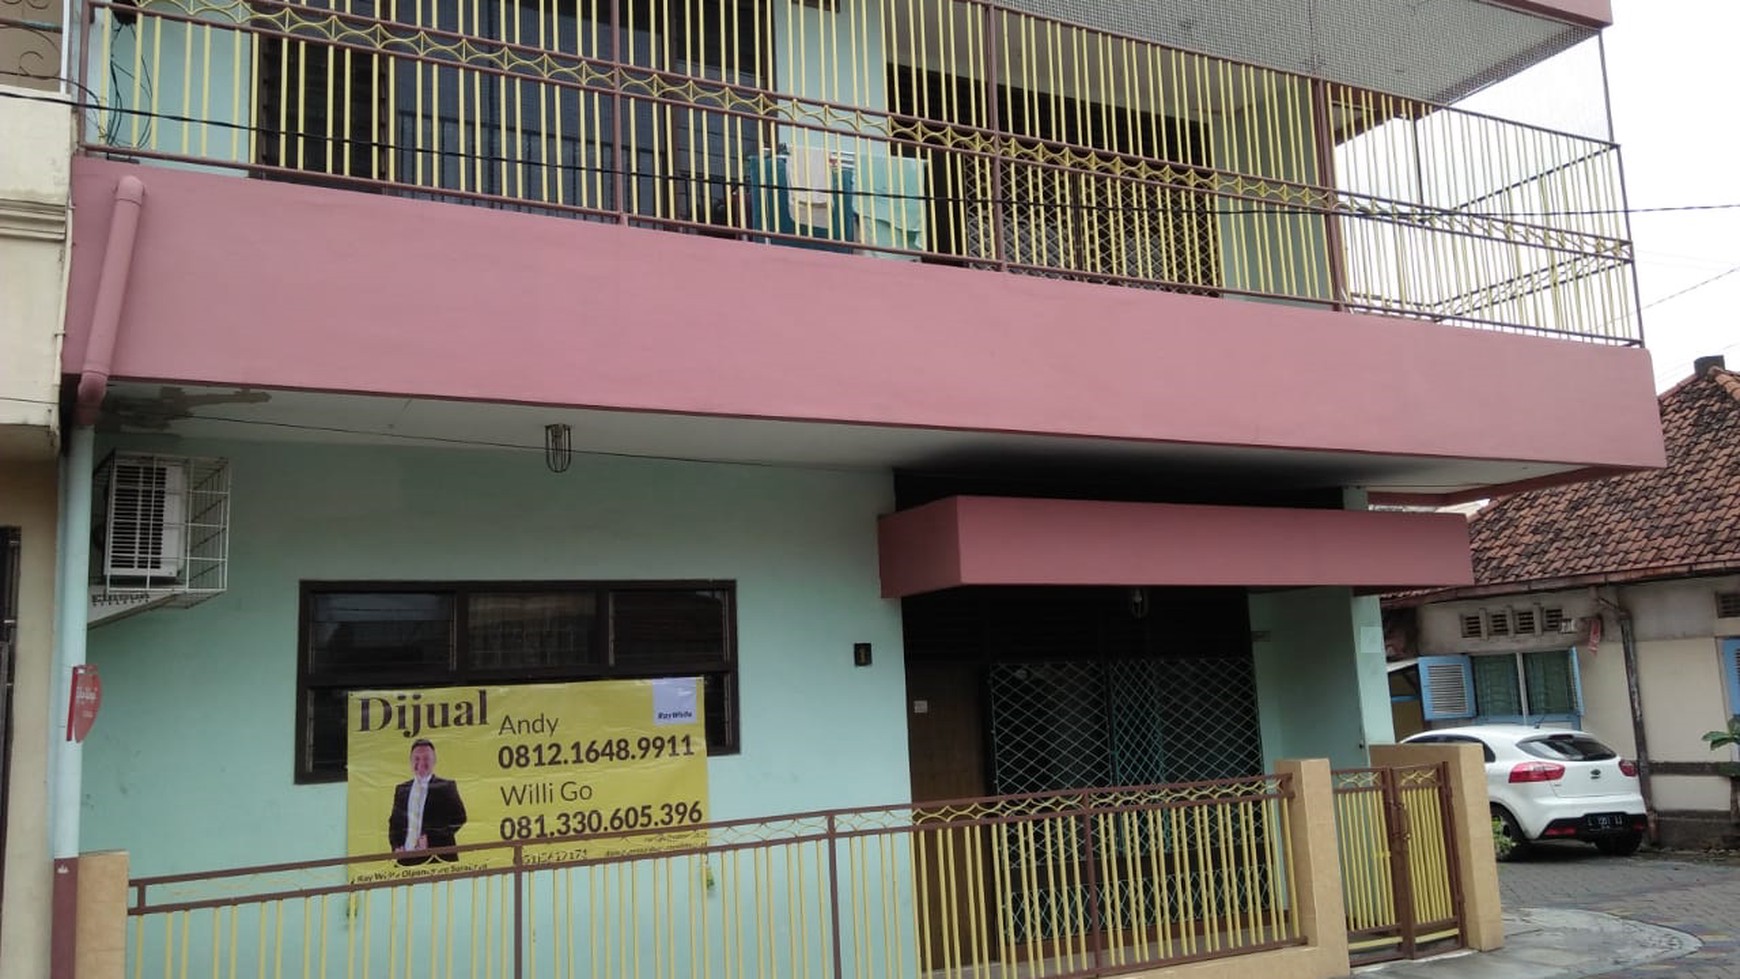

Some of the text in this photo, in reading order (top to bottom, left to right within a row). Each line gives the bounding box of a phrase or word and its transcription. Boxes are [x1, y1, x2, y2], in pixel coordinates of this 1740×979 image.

[357, 690, 489, 738] Dijual
[499, 713, 559, 736] Andy
[498, 734, 695, 769] 0812.1648.9911
[501, 781, 592, 806] Willi Go
[500, 801, 703, 841] 081.330.605.396
